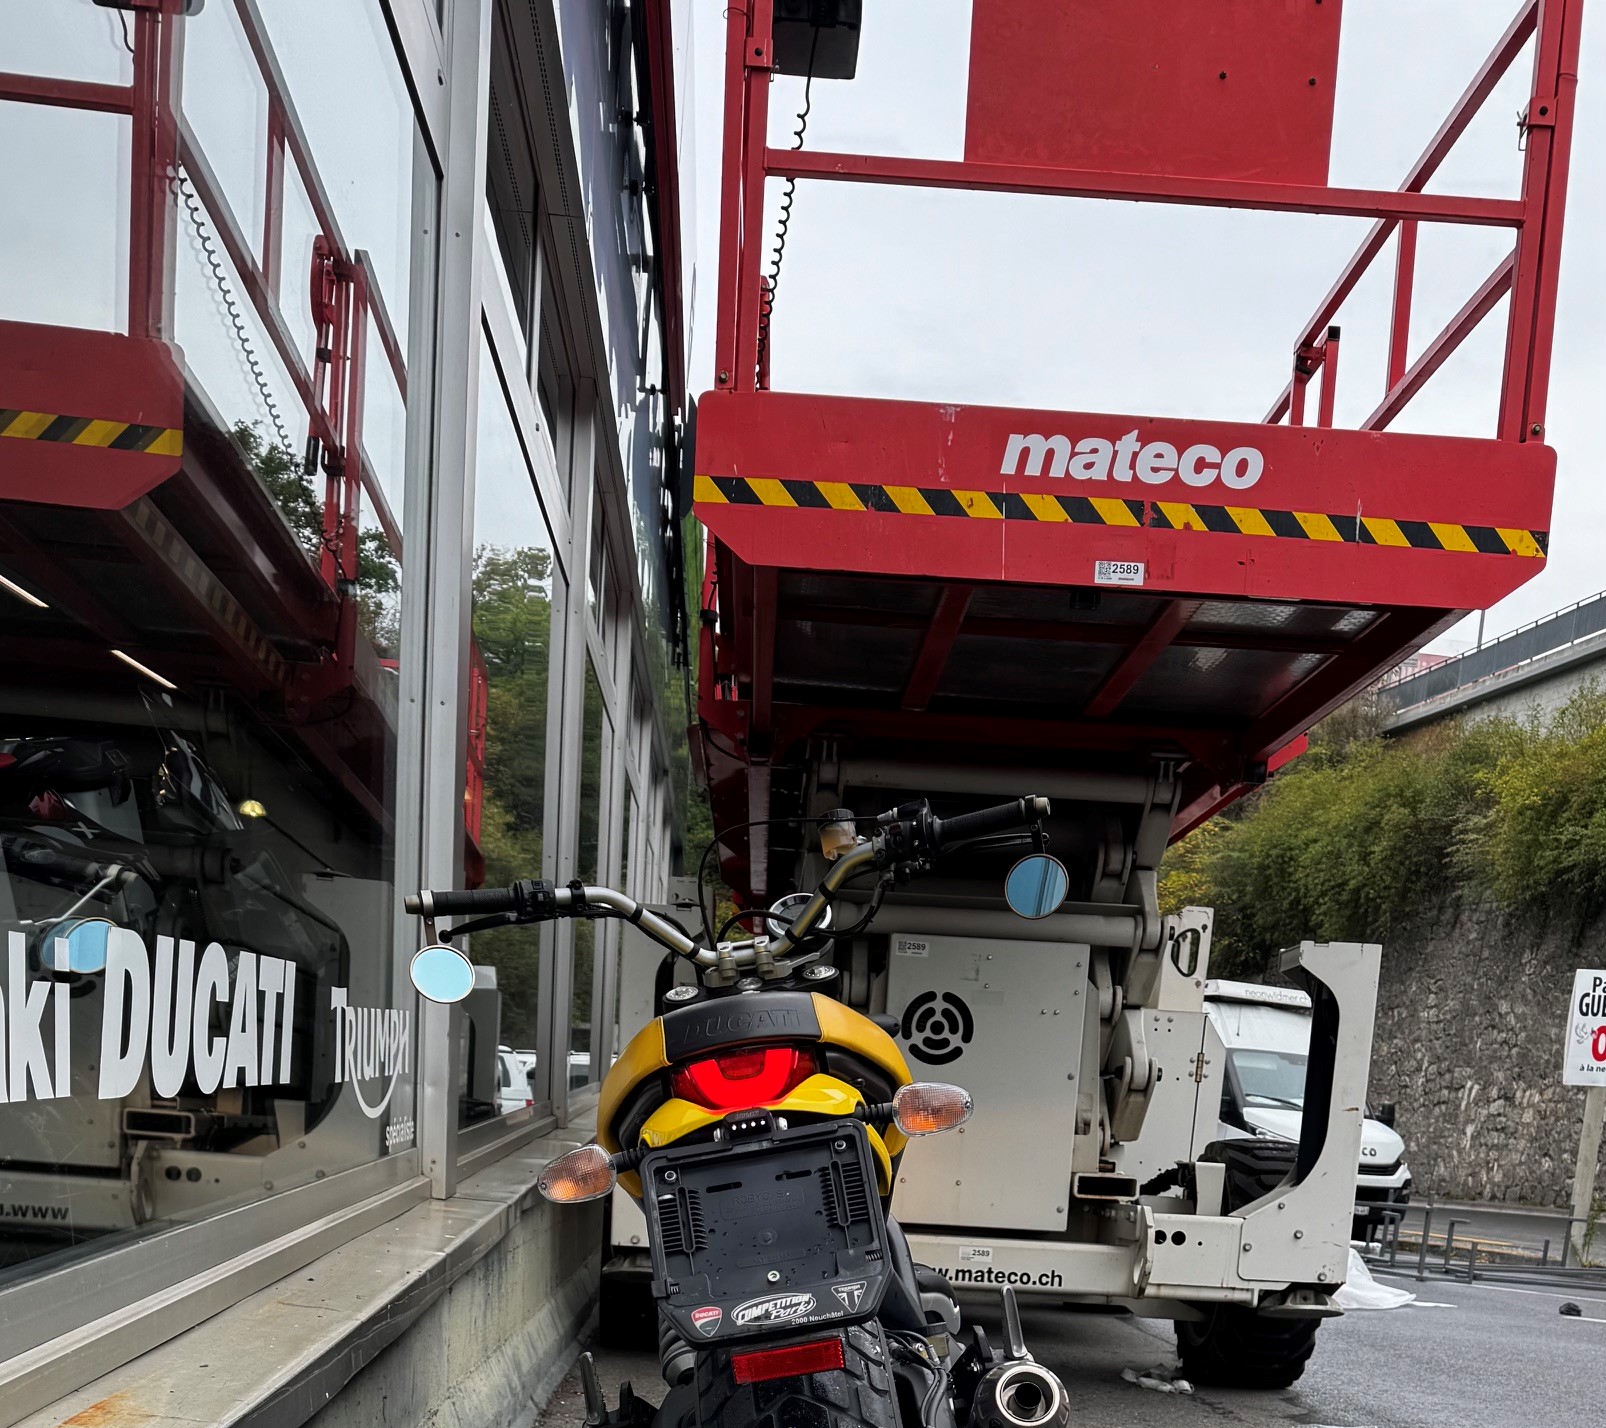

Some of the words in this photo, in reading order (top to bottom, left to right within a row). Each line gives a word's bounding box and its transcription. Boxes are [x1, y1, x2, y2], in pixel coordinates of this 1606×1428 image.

[1000, 429, 1264, 490] mateco
[1112, 563, 1139, 575] 2589
[907, 942, 927, 951] 2589
[0, 930, 71, 1104] ki
[98, 926, 297, 1100] DUCATI
[683, 1009, 800, 1044] DUCATI
[330, 985, 410, 1119] TRIUMPH
[1586, 1063, 1594, 1072] la
[385, 1115, 415, 1152] spécialiste
[972, 1249, 990, 1257] 2589
[695, 1310, 719, 1319] DUCATI
[736, 1293, 812, 1326] COMPETITION
[769, 1301, 809, 1320] Park
[791, 1315, 808, 1325] 2000
[809, 1310, 844, 1323] Neuchâtel
